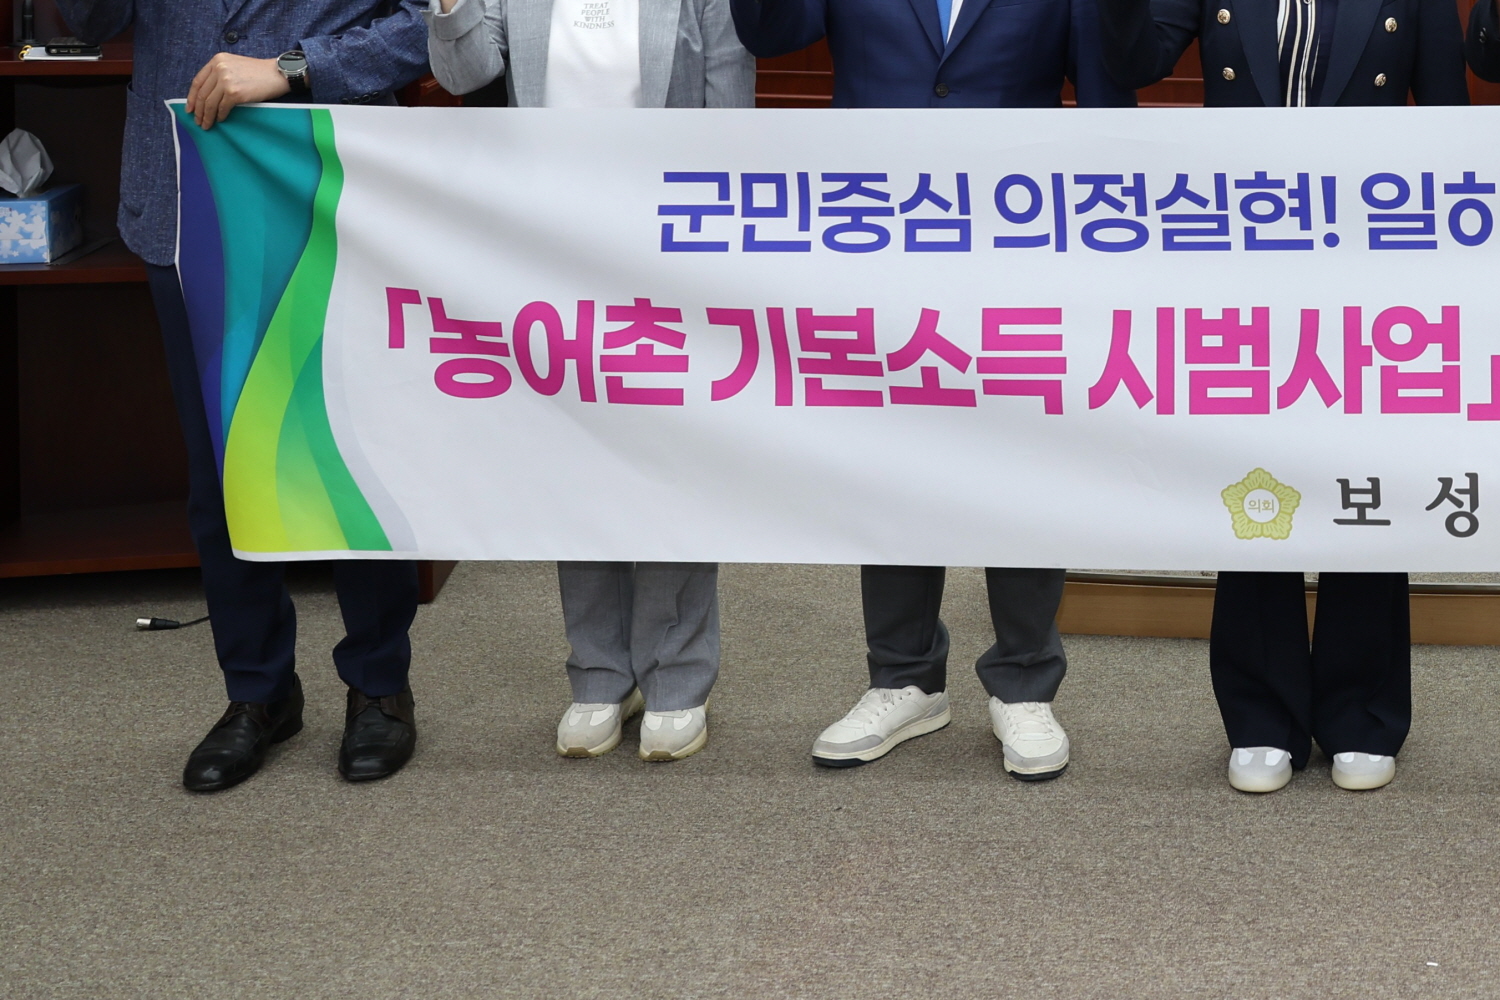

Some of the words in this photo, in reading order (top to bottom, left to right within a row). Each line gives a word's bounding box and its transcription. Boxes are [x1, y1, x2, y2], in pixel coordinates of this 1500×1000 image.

[581, 8, 610, 16] PEOPLE
[573, 20, 615, 30] KINDNESS
[658, 172, 971, 253] 군민중심
[994, 172, 1339, 252] 의정실현!
[707, 308, 1066, 414] 기본소득
[1248, 499, 1274, 513] 의회
